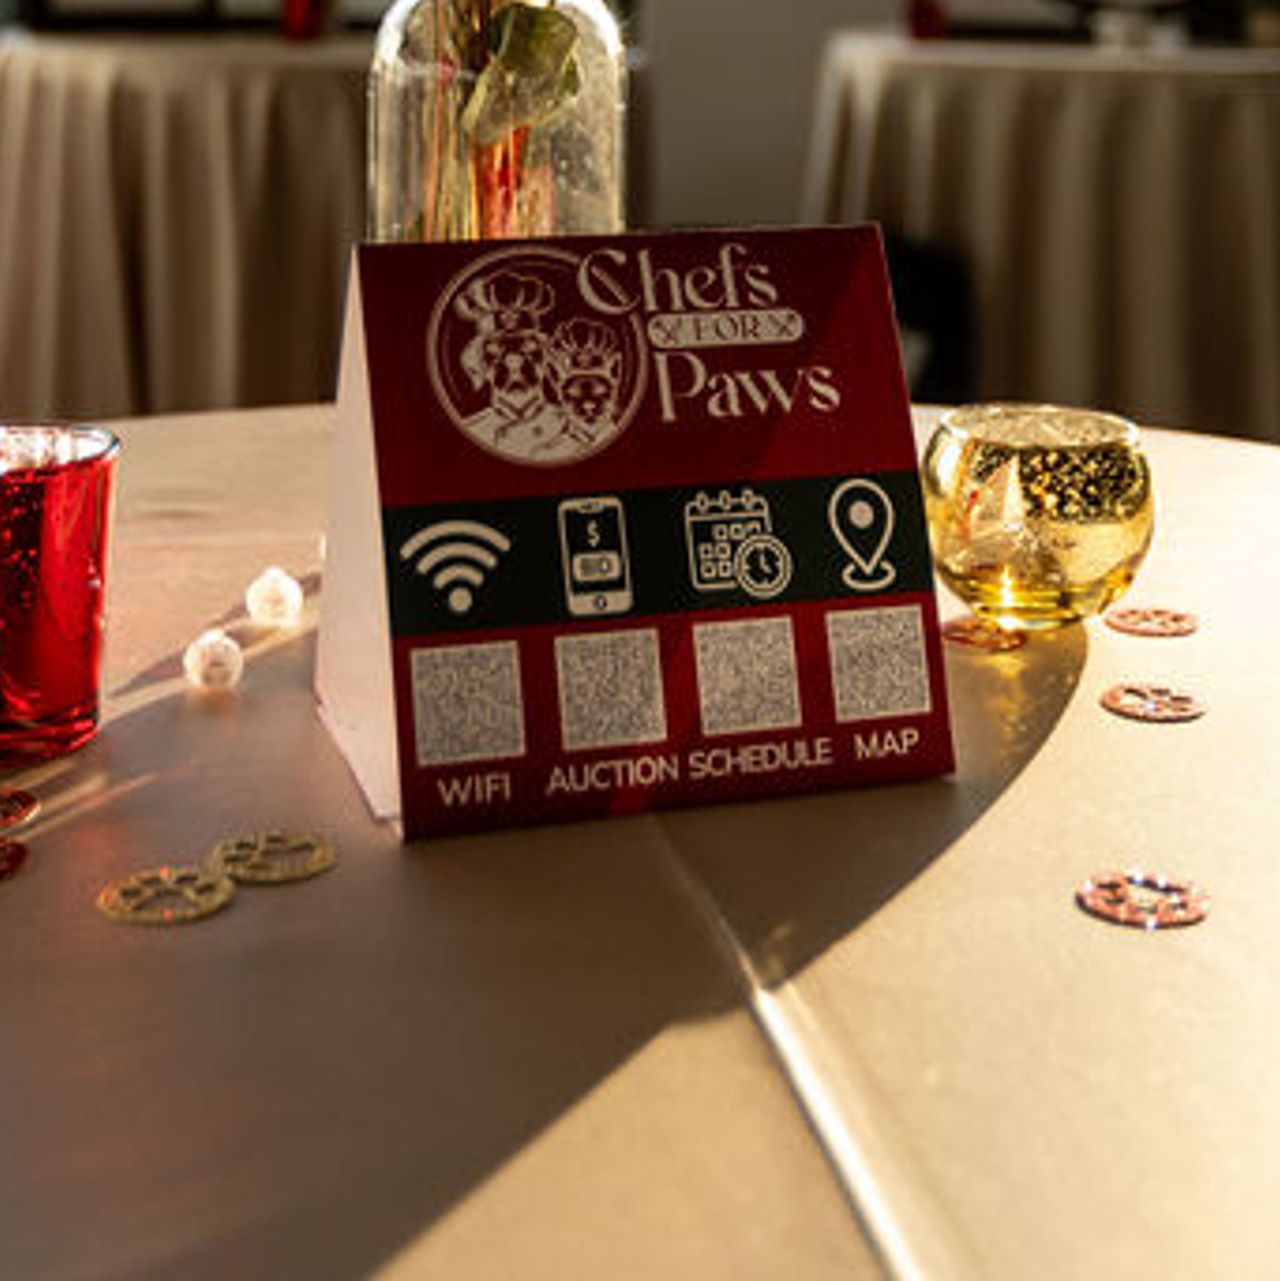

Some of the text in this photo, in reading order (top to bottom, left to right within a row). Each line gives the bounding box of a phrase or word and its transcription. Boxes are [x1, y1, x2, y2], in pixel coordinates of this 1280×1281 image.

[577, 242, 778, 315] Chefs
[694, 312, 761, 342] FOR
[654, 350, 841, 424] Paws
[436, 726, 920, 807] WIFI AUCTION SCHEDULE MAP
